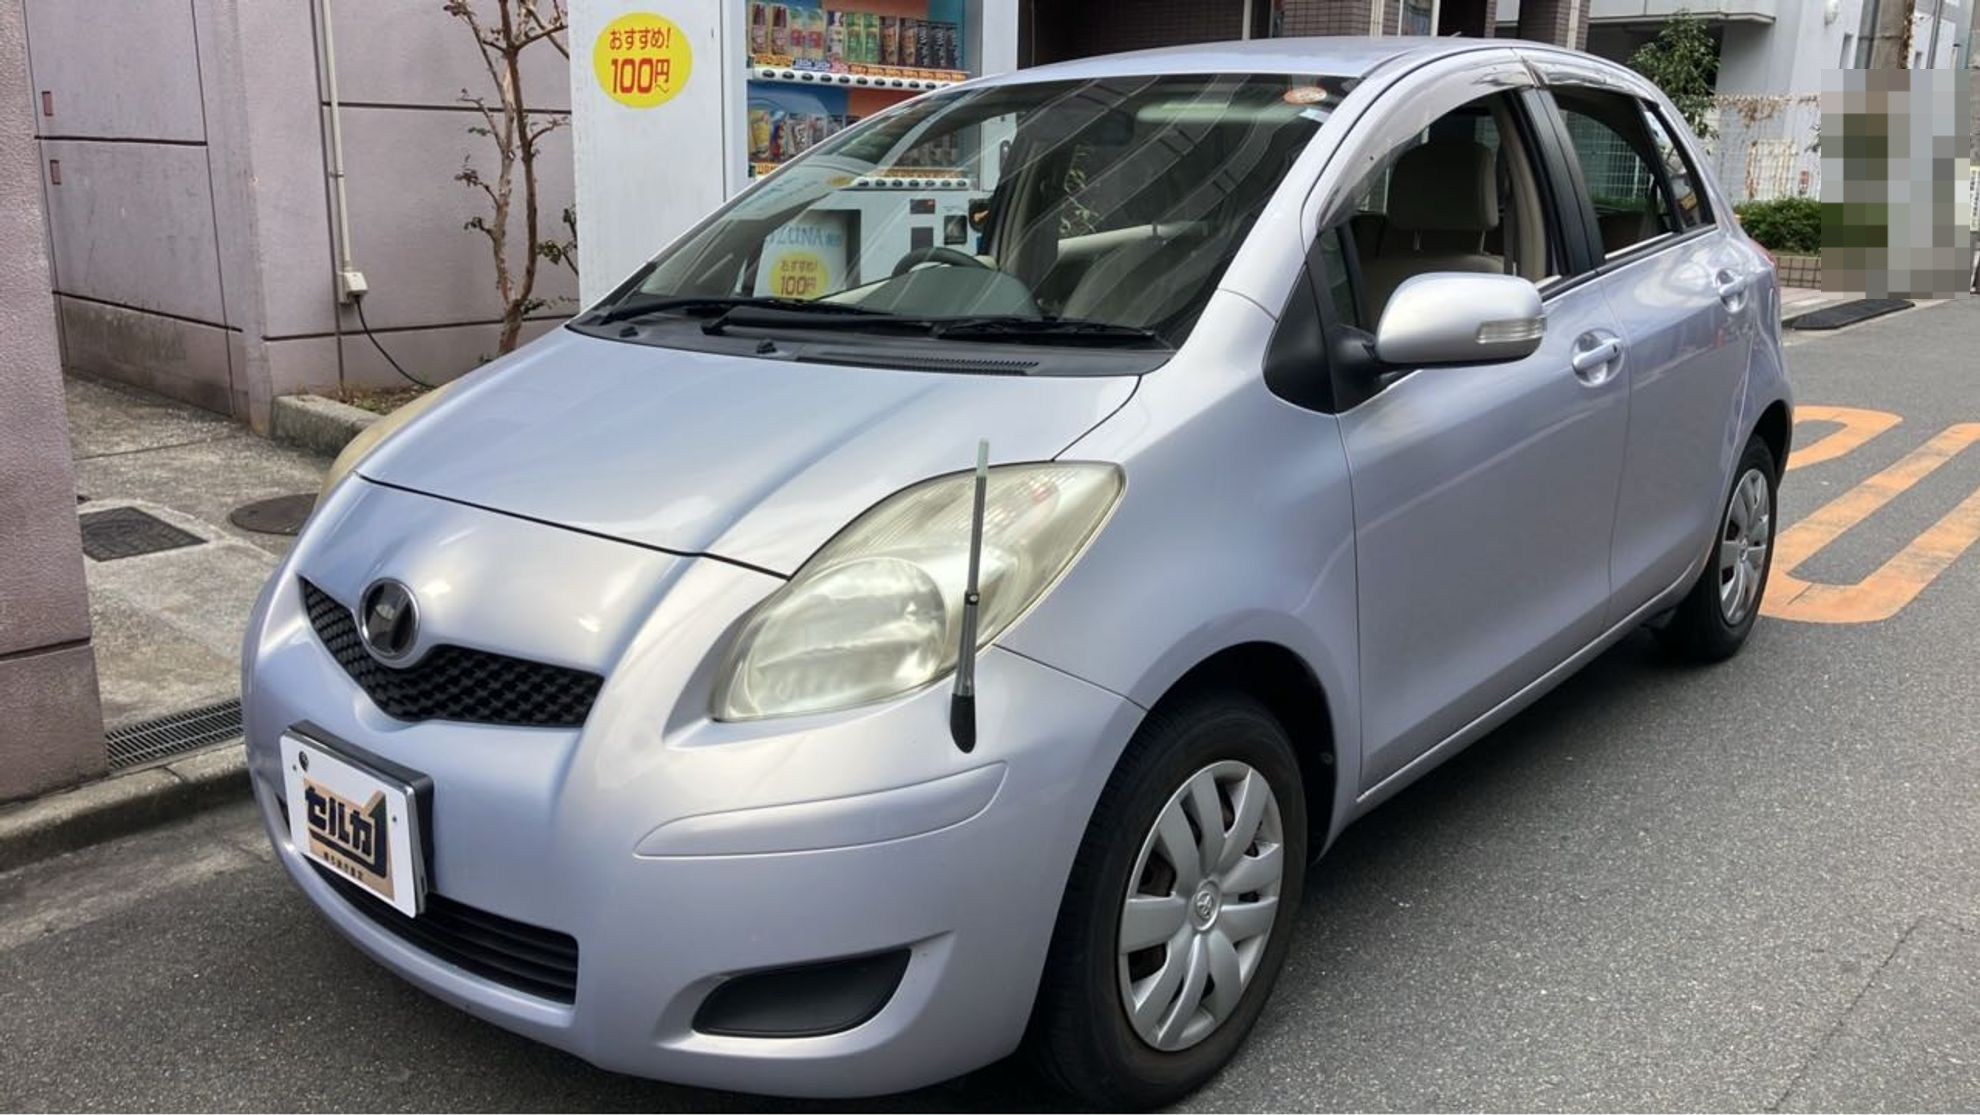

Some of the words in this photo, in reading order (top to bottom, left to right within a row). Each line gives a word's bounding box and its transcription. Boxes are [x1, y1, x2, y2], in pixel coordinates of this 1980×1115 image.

[609, 27, 671, 50] おすすめ!
[305, 785, 373, 857] セルカ
